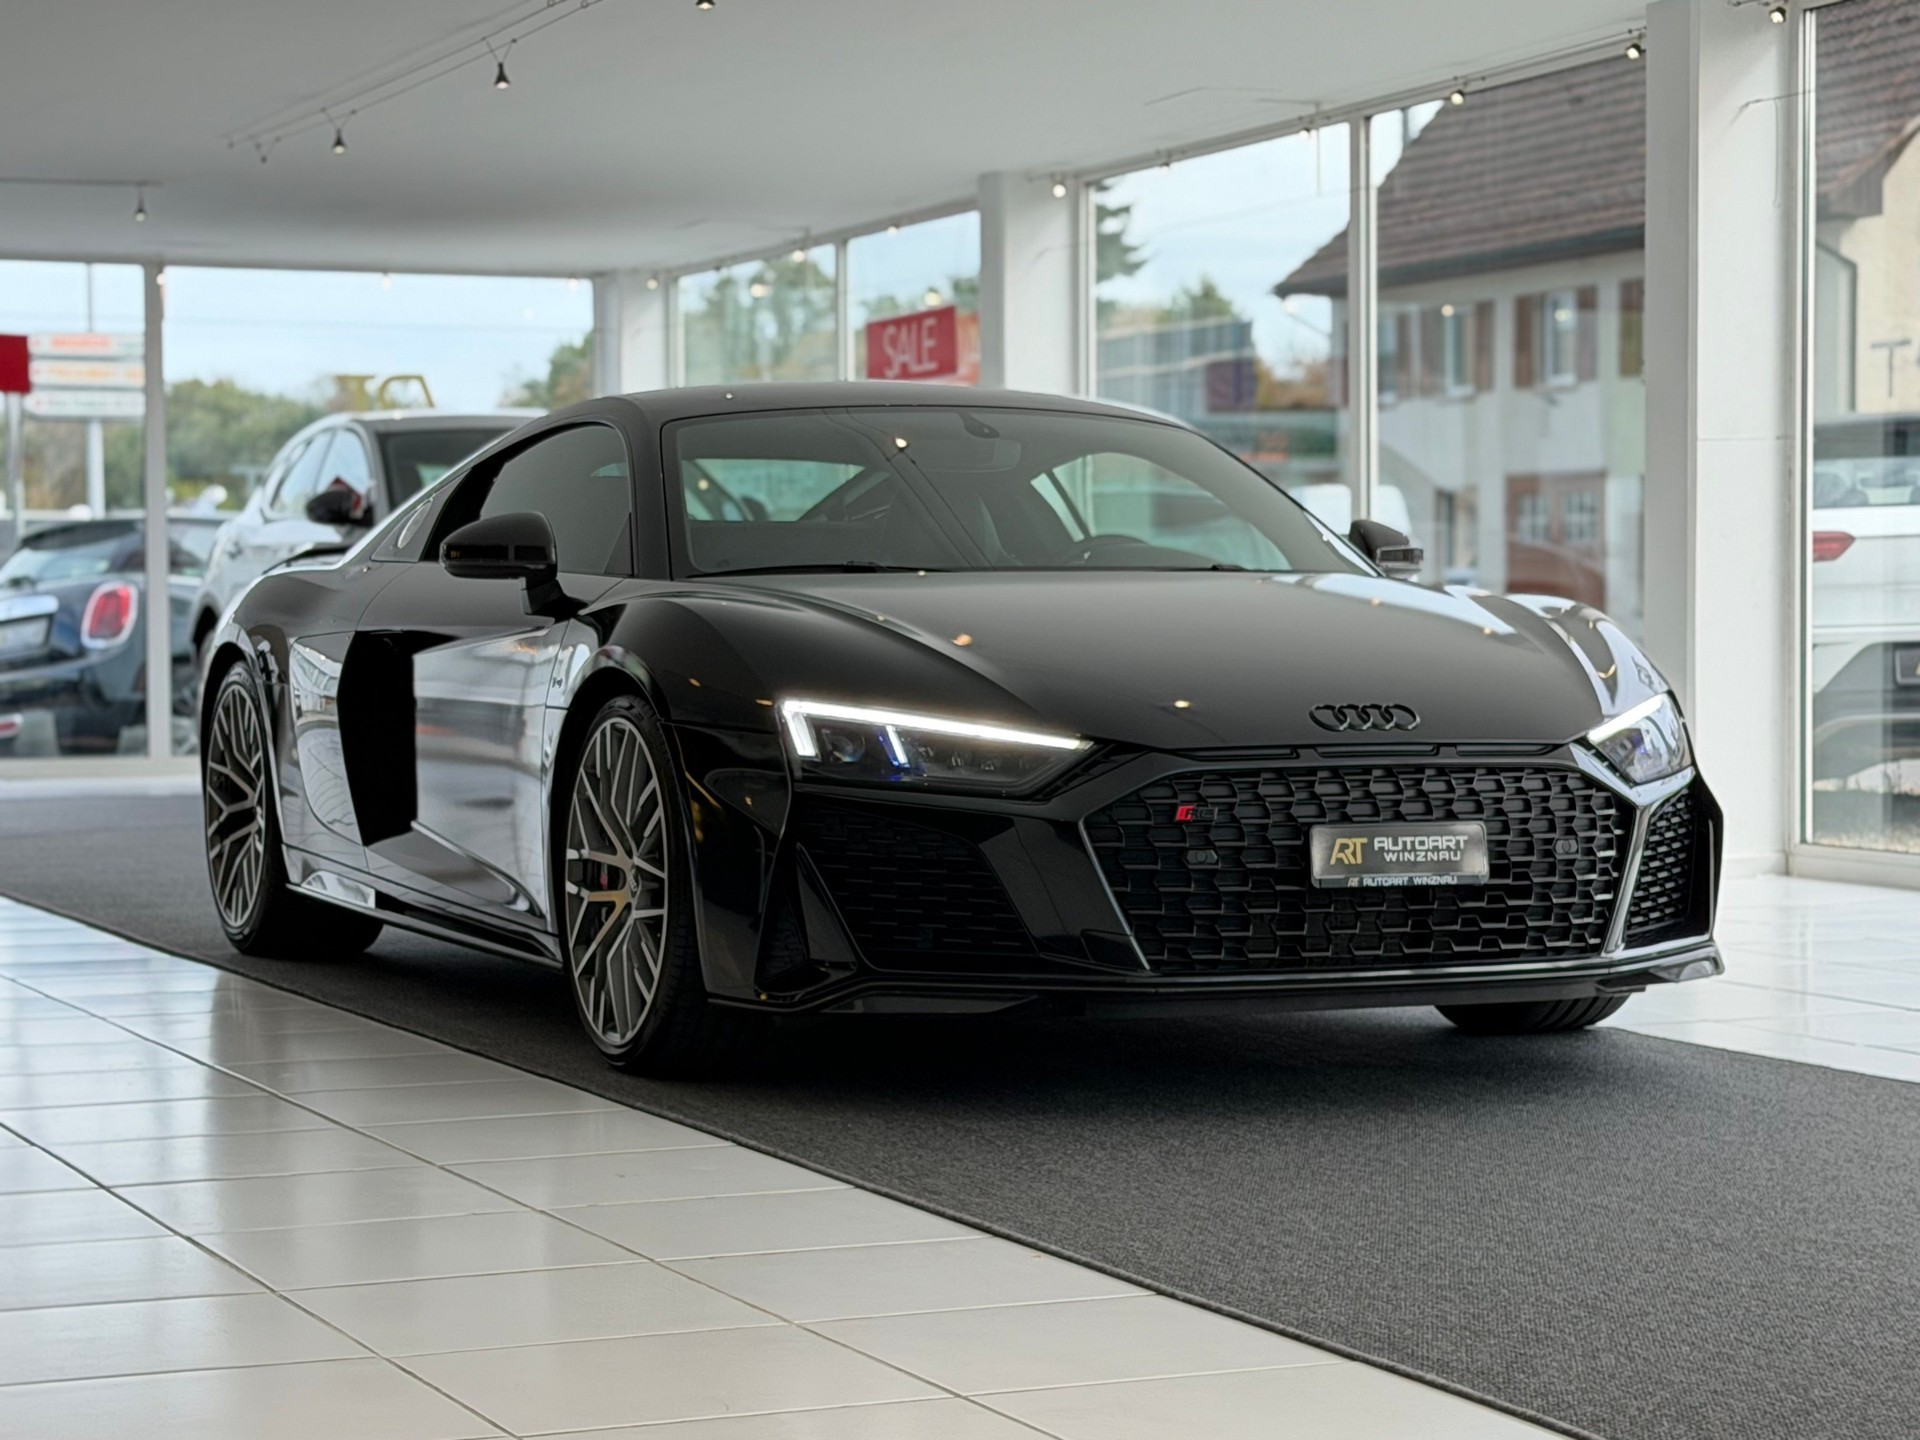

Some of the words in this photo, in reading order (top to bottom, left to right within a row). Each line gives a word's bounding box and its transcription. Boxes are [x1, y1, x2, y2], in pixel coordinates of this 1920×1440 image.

[882, 317, 938, 378] SALE
[1374, 836, 1469, 851] AUTOART
[1384, 851, 1461, 862] WINZNAU
[1363, 876, 1408, 887] AUTOART
[1413, 875, 1457, 885] WINZNAU
